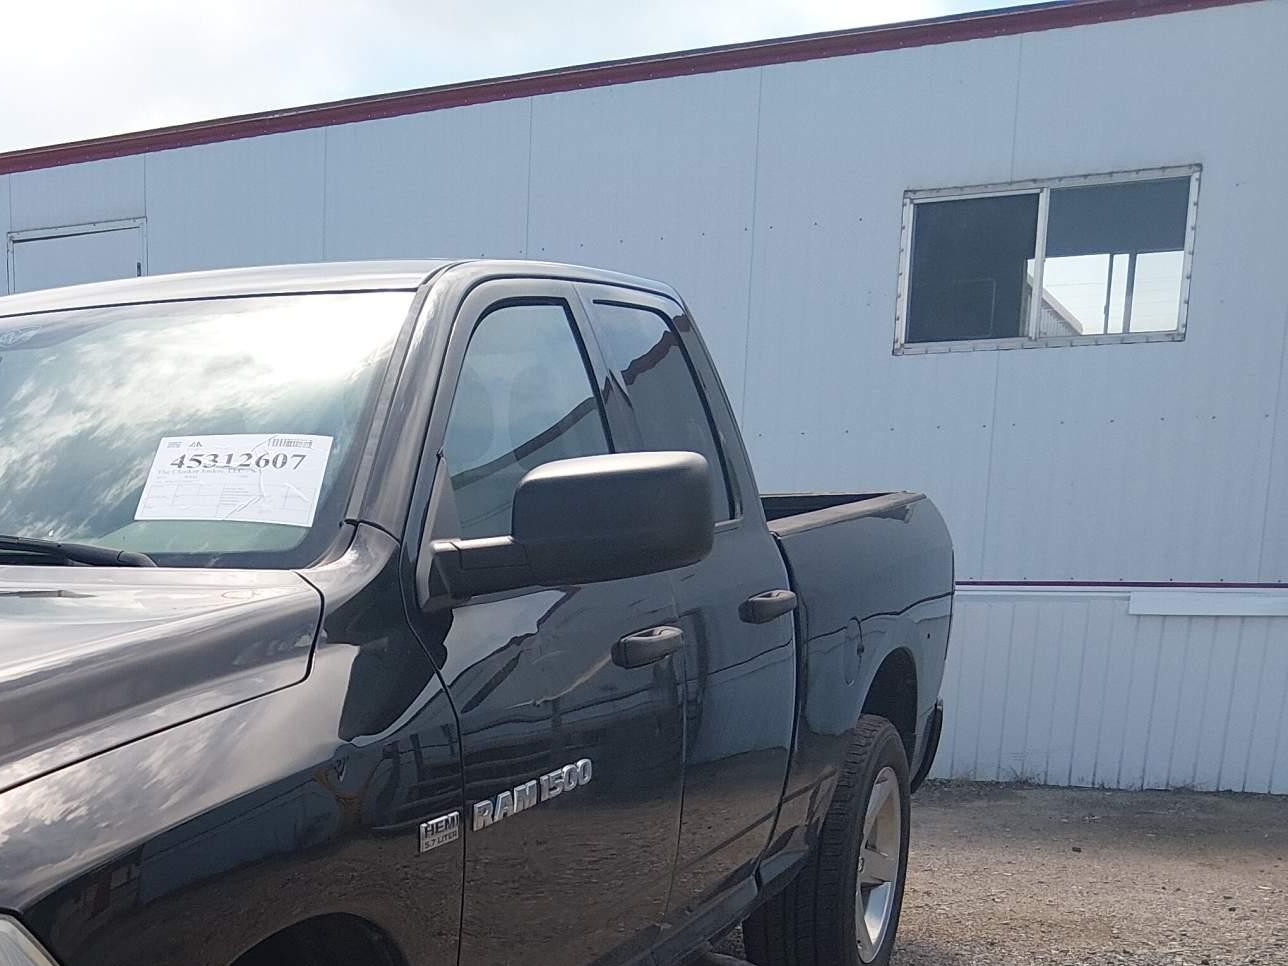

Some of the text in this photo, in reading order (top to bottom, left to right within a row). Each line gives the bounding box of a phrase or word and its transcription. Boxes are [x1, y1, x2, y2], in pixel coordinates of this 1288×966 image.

[169, 452, 307, 470] 45312607
[472, 758, 593, 832] RAM 1500
[423, 813, 459, 838] HEMI
